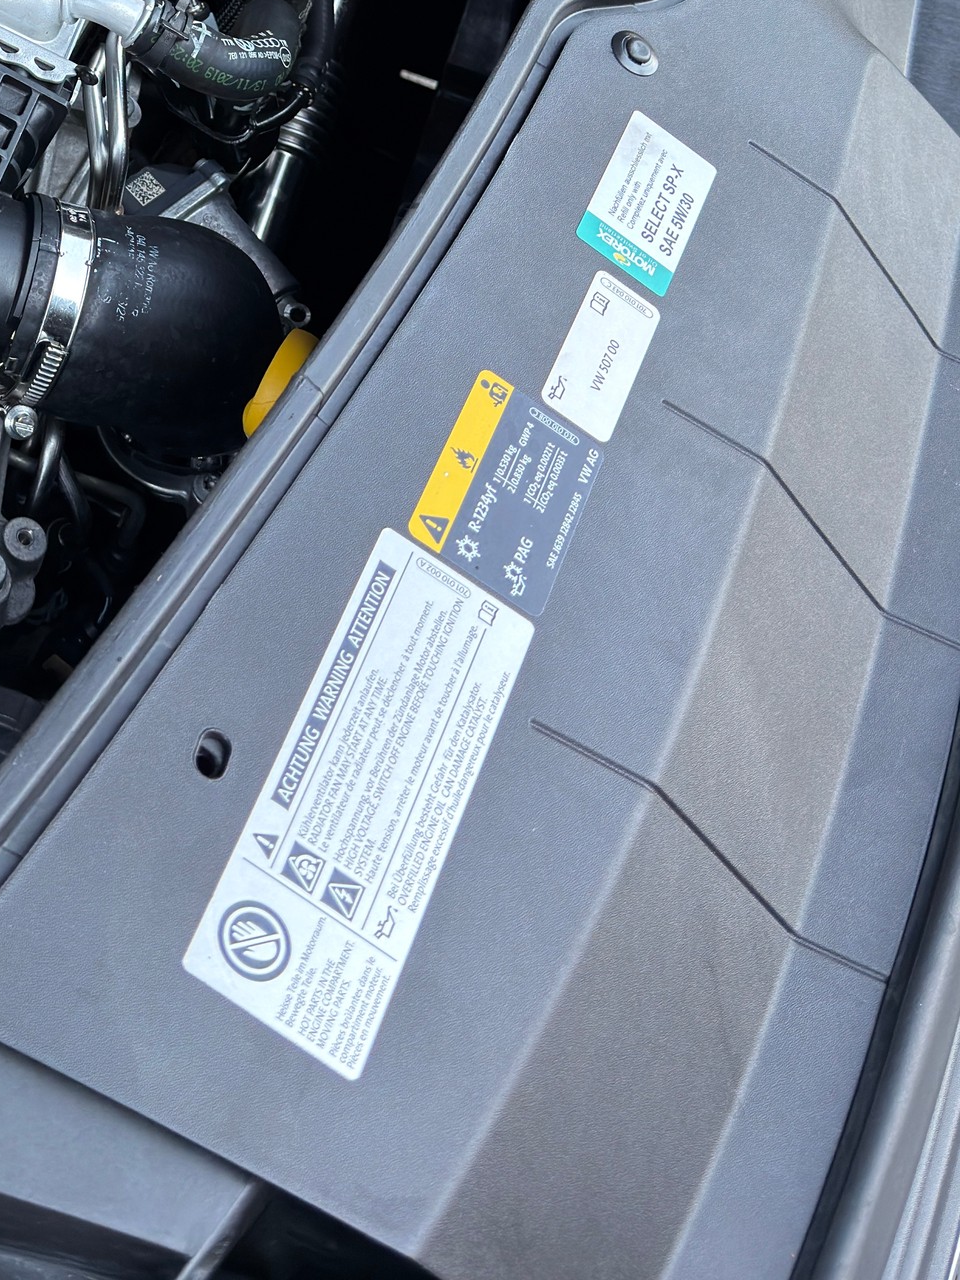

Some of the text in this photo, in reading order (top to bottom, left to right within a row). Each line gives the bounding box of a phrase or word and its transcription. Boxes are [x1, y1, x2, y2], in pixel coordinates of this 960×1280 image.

[204, 67, 268, 92] 13/11/2019
[616, 179, 641, 223] Refill only with
[641, 161, 662, 198] uniquement
[657, 148, 668, 164] avec
[640, 162, 684, 244] SELECT SP-X
[658, 191, 694, 257] SAE 5W/30
[595, 227, 656, 276] MOTOREX
[589, 338, 620, 392] VW 507 00
[496, 453, 511, 476] 0.530
[504, 443, 517, 456] kg
[517, 421, 534, 447] GWP 4
[537, 446, 553, 472] 0.0021
[510, 462, 525, 485] 0.830
[518, 452, 532, 466] kg
[549, 454, 565, 481] 0.0033
[577, 447, 599, 485] VW AG
[467, 481, 499, 534] R-1234yf
[558, 512, 574, 537] J2842
[513, 535, 533, 564] PAG
[545, 551, 558, 569] SAE
[552, 533, 565, 554] J639
[276, 569, 391, 803] ACHTUNG WARNING ATTENTION
[296, 666, 379, 839] Kühlerventilator kann jederzeit anlaufen.
[306, 675, 388, 846] RADIATOR FAN MAY START AT ANY TIME.
[332, 608, 448, 864] Hochspannung, vor Berühren der Zündanlage Motor abstellen.
[342, 596, 464, 870] HIGH VOLTAGE, SWITCH OFF ENGINE BEFORE TOUCHING IGNITION
[386, 680, 483, 899] Bei Überfüllung besteht Gefahr für den Katalysator.
[396, 695, 488, 906] OVERFILLED ENGINE OIL CAN DAMAGE CATALYST.
[353, 836, 376, 877] SYSTEM.
[274, 914, 327, 1021] Heisse Teile im Motorraum.
[284, 965, 317, 1028] Bewegte Teile.
[297, 957, 335, 1036] HOT PARTS IN THE
[306, 939, 355, 1042] ENGINE COMPARTMENT.
[315, 977, 351, 1049] MOVING PARTS.
[328, 954, 376, 1058] Pièces brûlantes dans le
[338, 966, 382, 1064] compartiment moteur.
[345, 973, 391, 1070] Pièces en mouvement.
